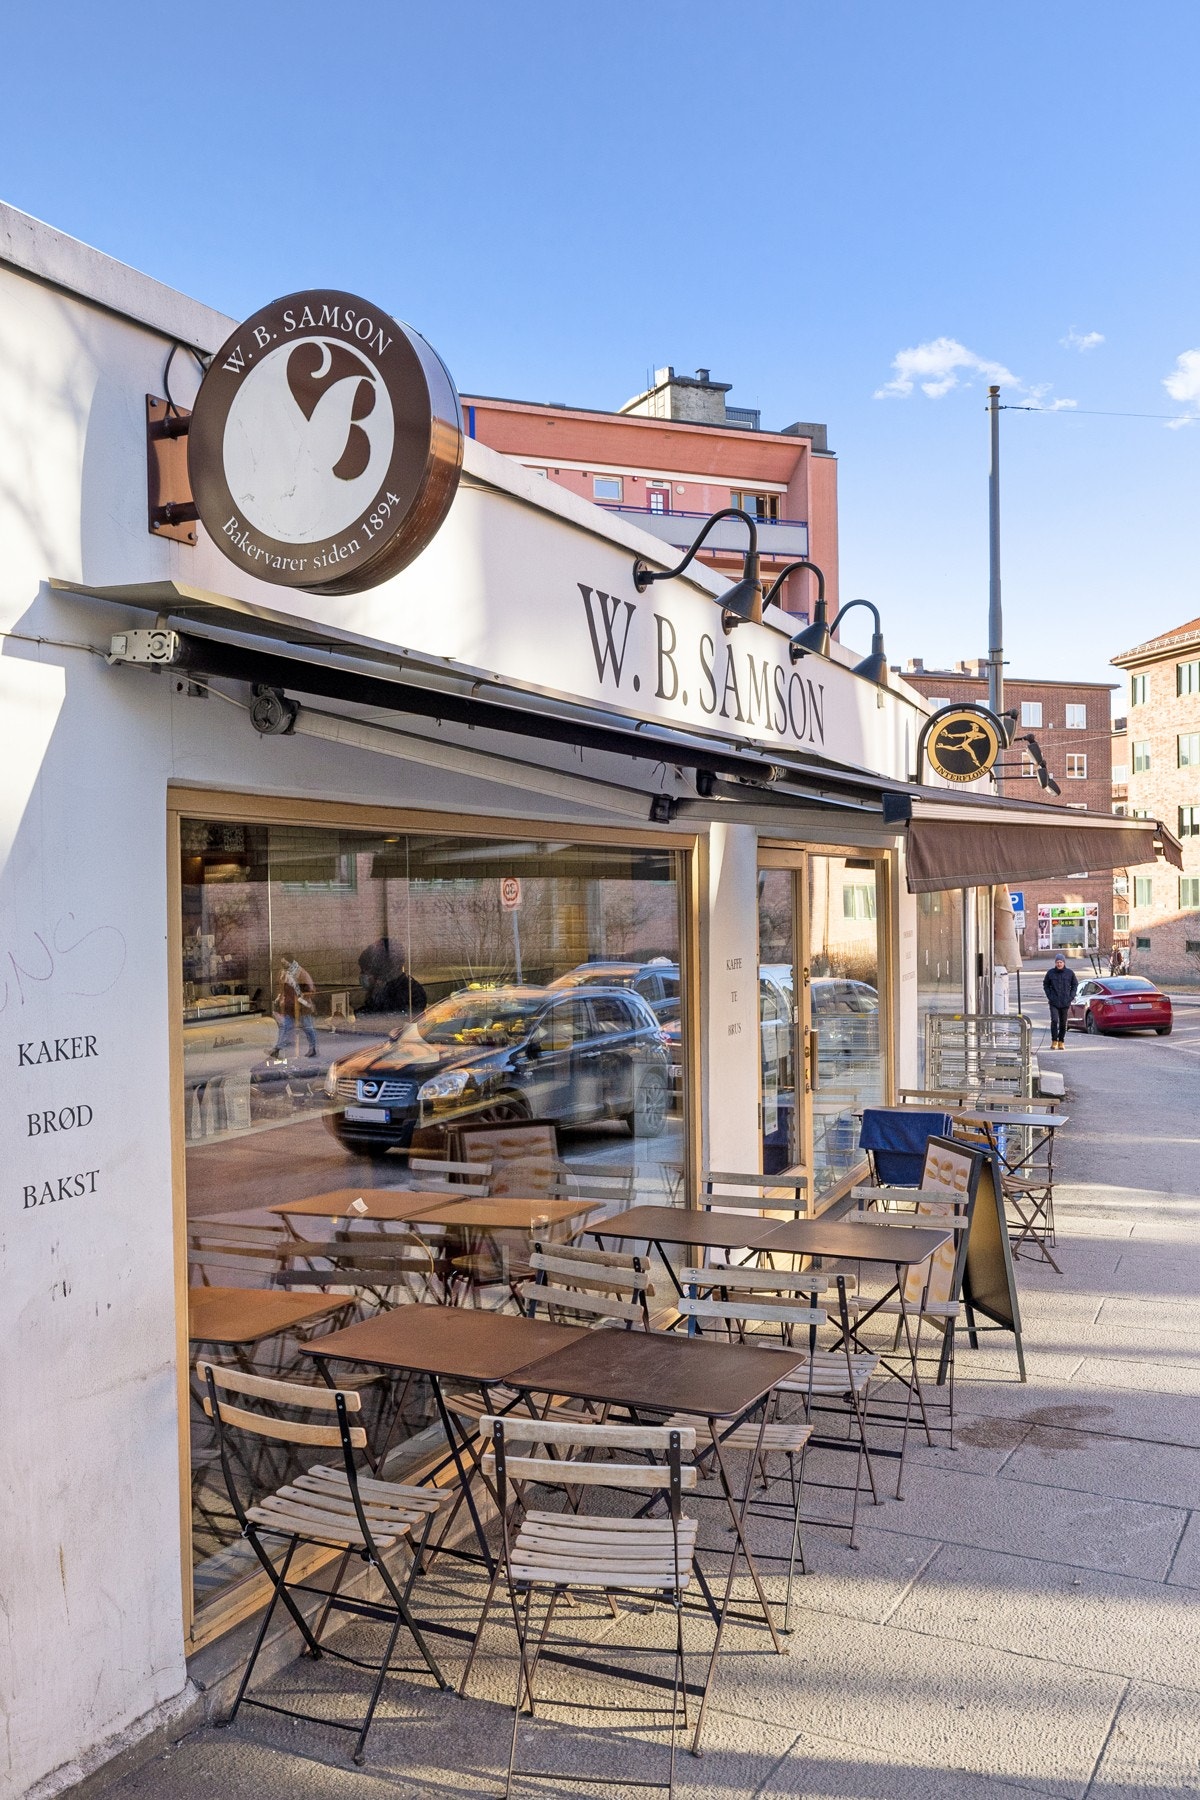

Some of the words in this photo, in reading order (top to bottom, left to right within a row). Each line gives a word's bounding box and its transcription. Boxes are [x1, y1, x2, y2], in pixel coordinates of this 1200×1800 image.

[221, 345, 253, 376] W.
[252, 325, 278, 349] B.
[283, 304, 393, 356] SAMSON
[221, 516, 307, 571] Bakervarer
[313, 537, 361, 569] siden
[360, 490, 401, 540] 1894
[577, 582, 641, 692] W.
[653, 613, 688, 706] B.
[699, 633, 825, 746] SAMSON
[936, 765, 990, 781] INTERFLORA
[726, 958, 743, 971] KAFFE
[17, 1035, 99, 1067] KAKER
[27, 1104, 94, 1137] BRØD
[22, 1170, 100, 1210] BAKST
